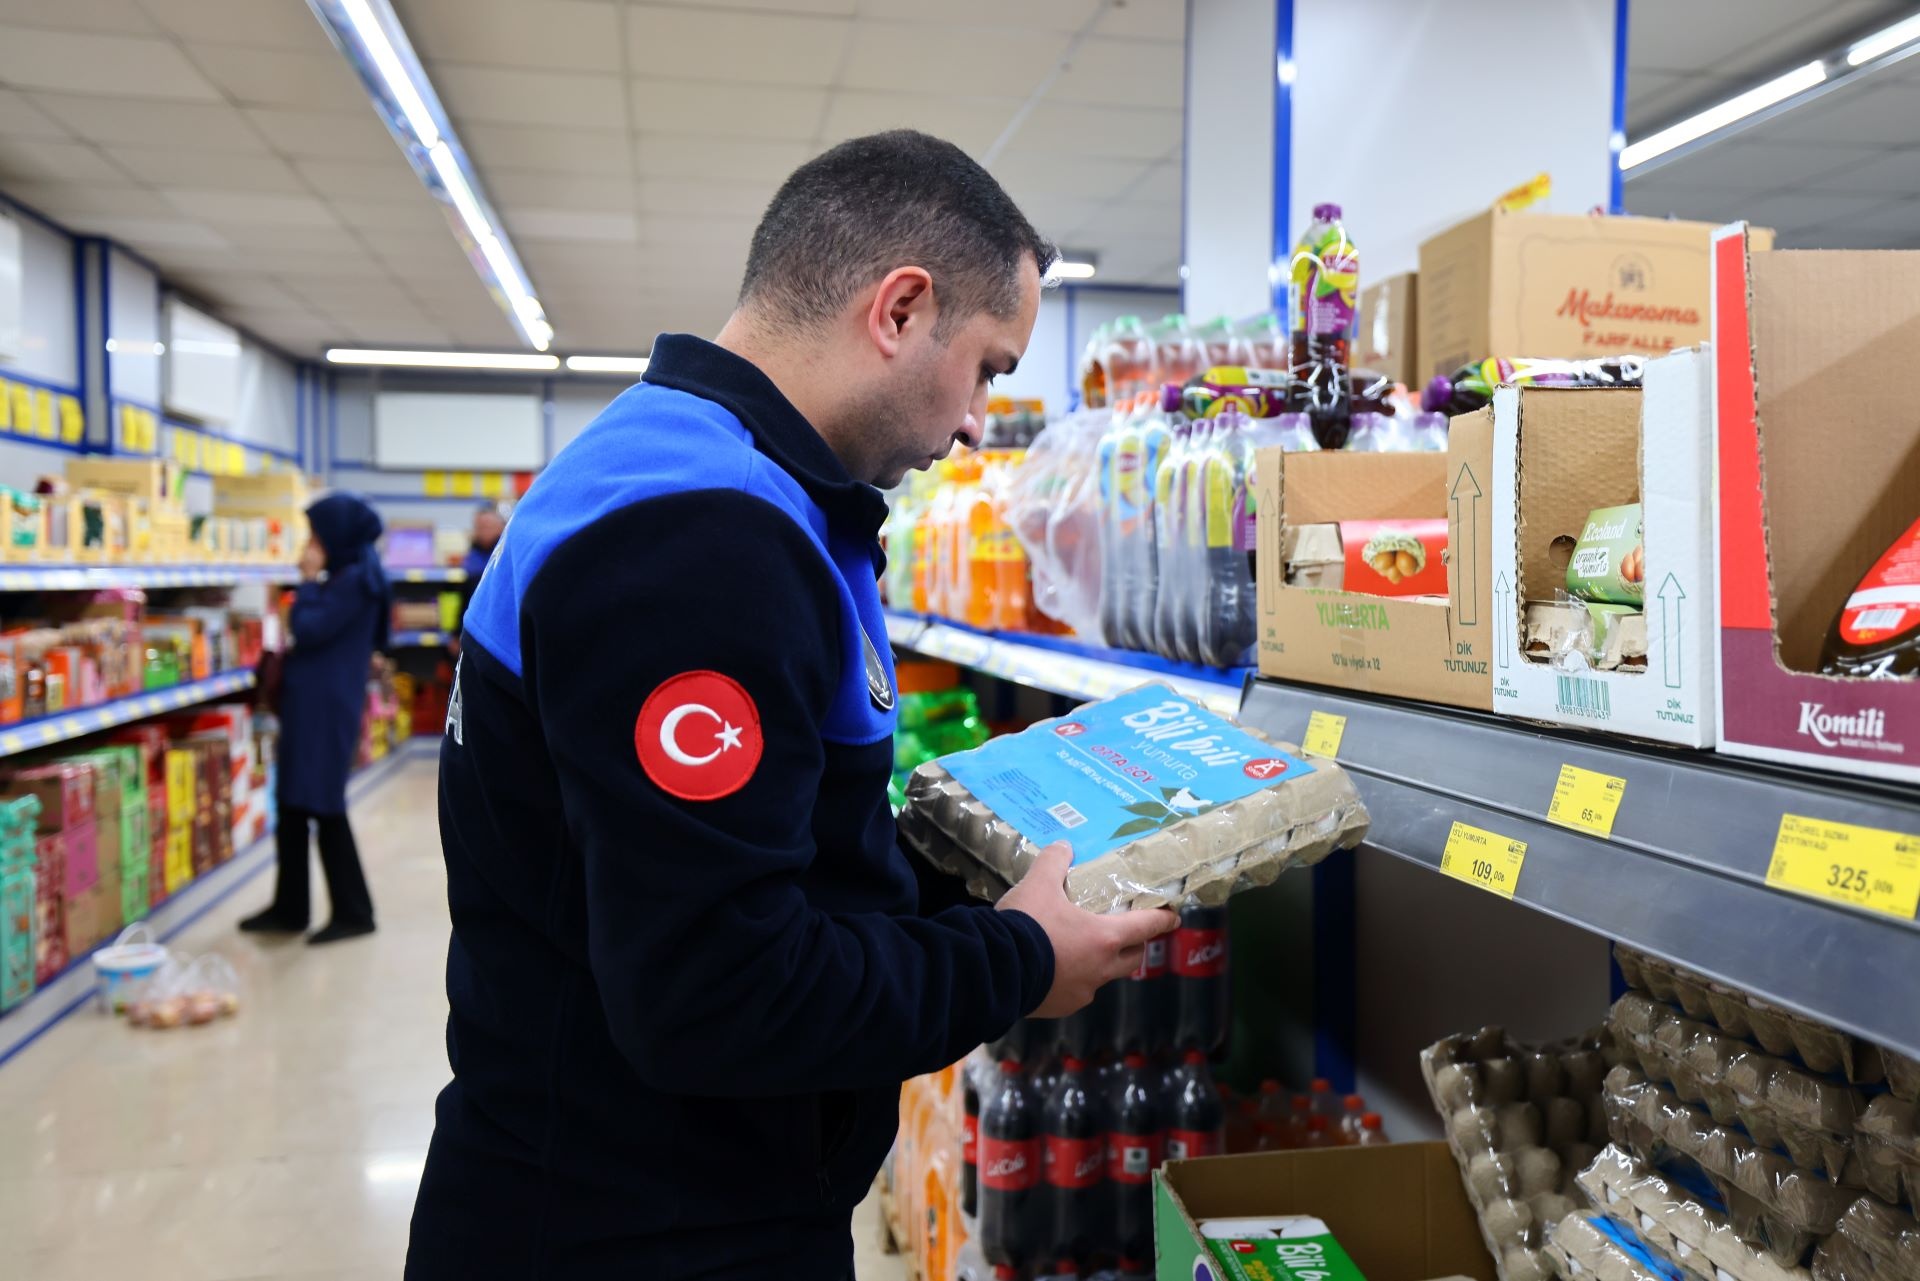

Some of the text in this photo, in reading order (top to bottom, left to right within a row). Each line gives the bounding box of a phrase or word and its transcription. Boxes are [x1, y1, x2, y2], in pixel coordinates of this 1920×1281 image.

[1583, 331, 1675, 350] FARFALLE
[1582, 517, 1628, 542] Ecoland
[1316, 602, 1390, 631] YUMURTA
[1456, 640, 1473, 656] DİK
[1372, 657, 1381, 671] 12
[1444, 659, 1488, 675] TUTUNUZ
[1494, 687, 1518, 699] TUTUNUZ
[1667, 698, 1682, 710] DİK
[1656, 710, 1694, 724] TUTUNUZ
[1797, 701, 1885, 747] Komili
[1090, 744, 1156, 784] ORTA BOY
[1130, 739, 1198, 781] yumurta
[1463, 831, 1488, 846] YUMURTA
